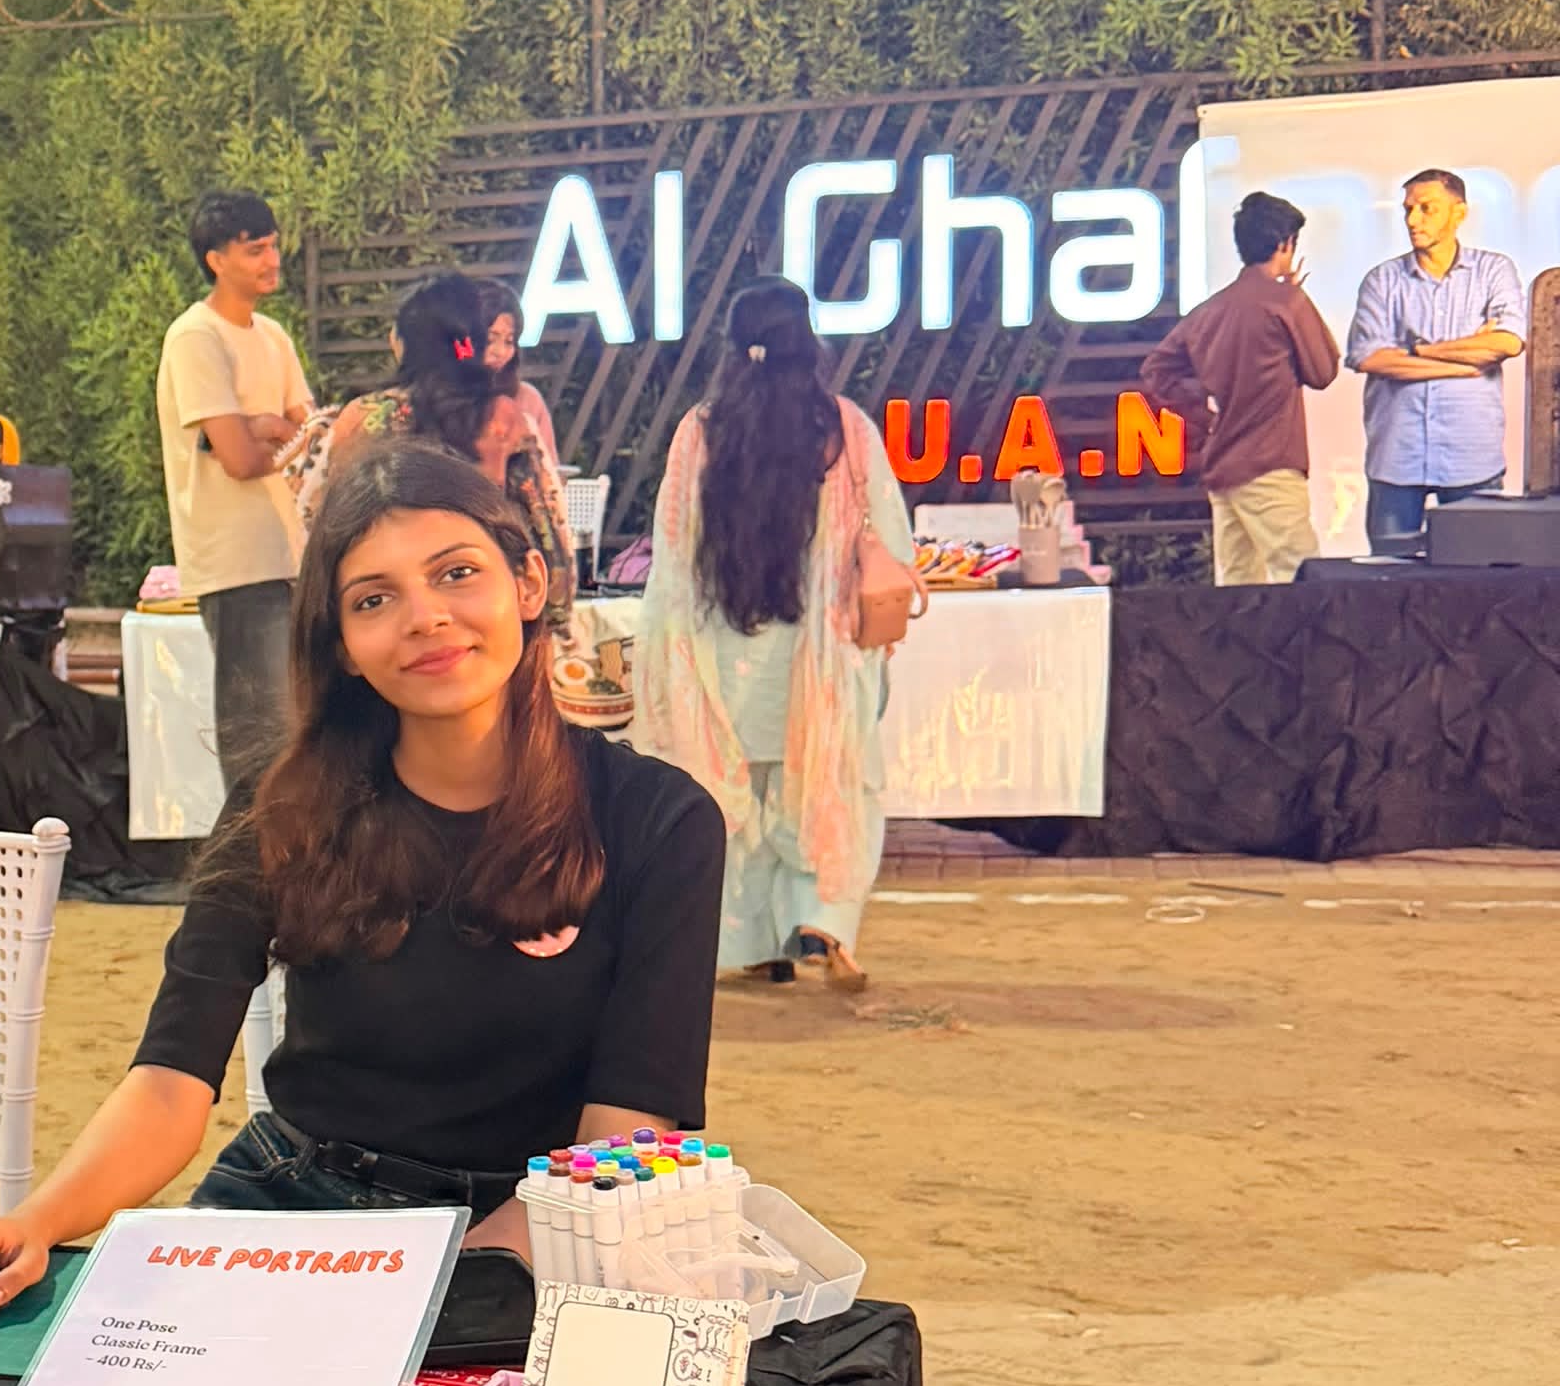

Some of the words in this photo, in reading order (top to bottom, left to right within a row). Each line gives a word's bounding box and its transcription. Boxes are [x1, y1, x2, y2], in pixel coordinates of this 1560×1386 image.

[886, 391, 1186, 484] U.A.N
[147, 1246, 221, 1267] LIVE
[224, 1248, 404, 1274] PORTRAITS
[101, 1316, 136, 1330] One
[137, 1319, 178, 1334] Pose
[91, 1334, 151, 1351] Classic
[152, 1340, 207, 1356] Frame
[97, 1355, 131, 1368] 400
[132, 1357, 168, 1372] Rs/-
